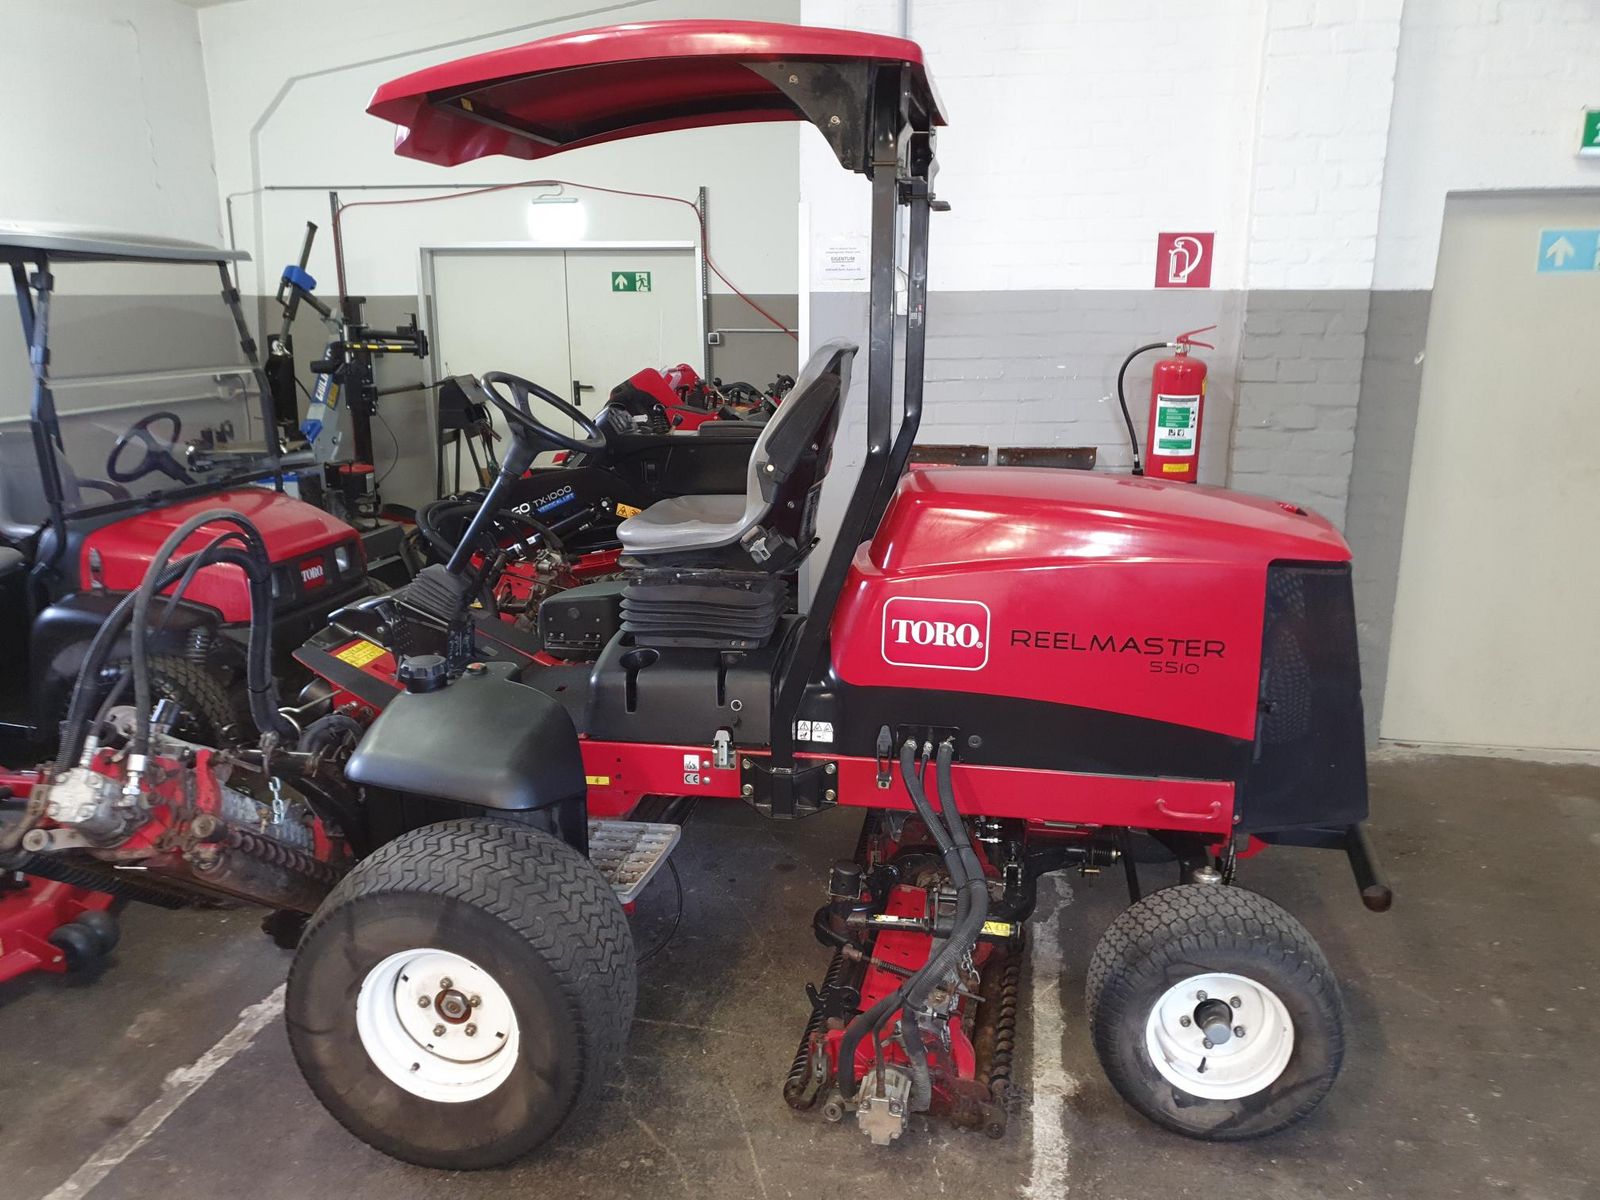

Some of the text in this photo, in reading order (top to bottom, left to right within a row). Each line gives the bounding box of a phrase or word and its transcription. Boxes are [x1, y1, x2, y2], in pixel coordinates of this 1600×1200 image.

[300, 564, 324, 582] TORO
[1009, 629, 1226, 658] REELMASTER
[1149, 661, 1200, 675] 5510
[684, 773, 699, 784] CE
